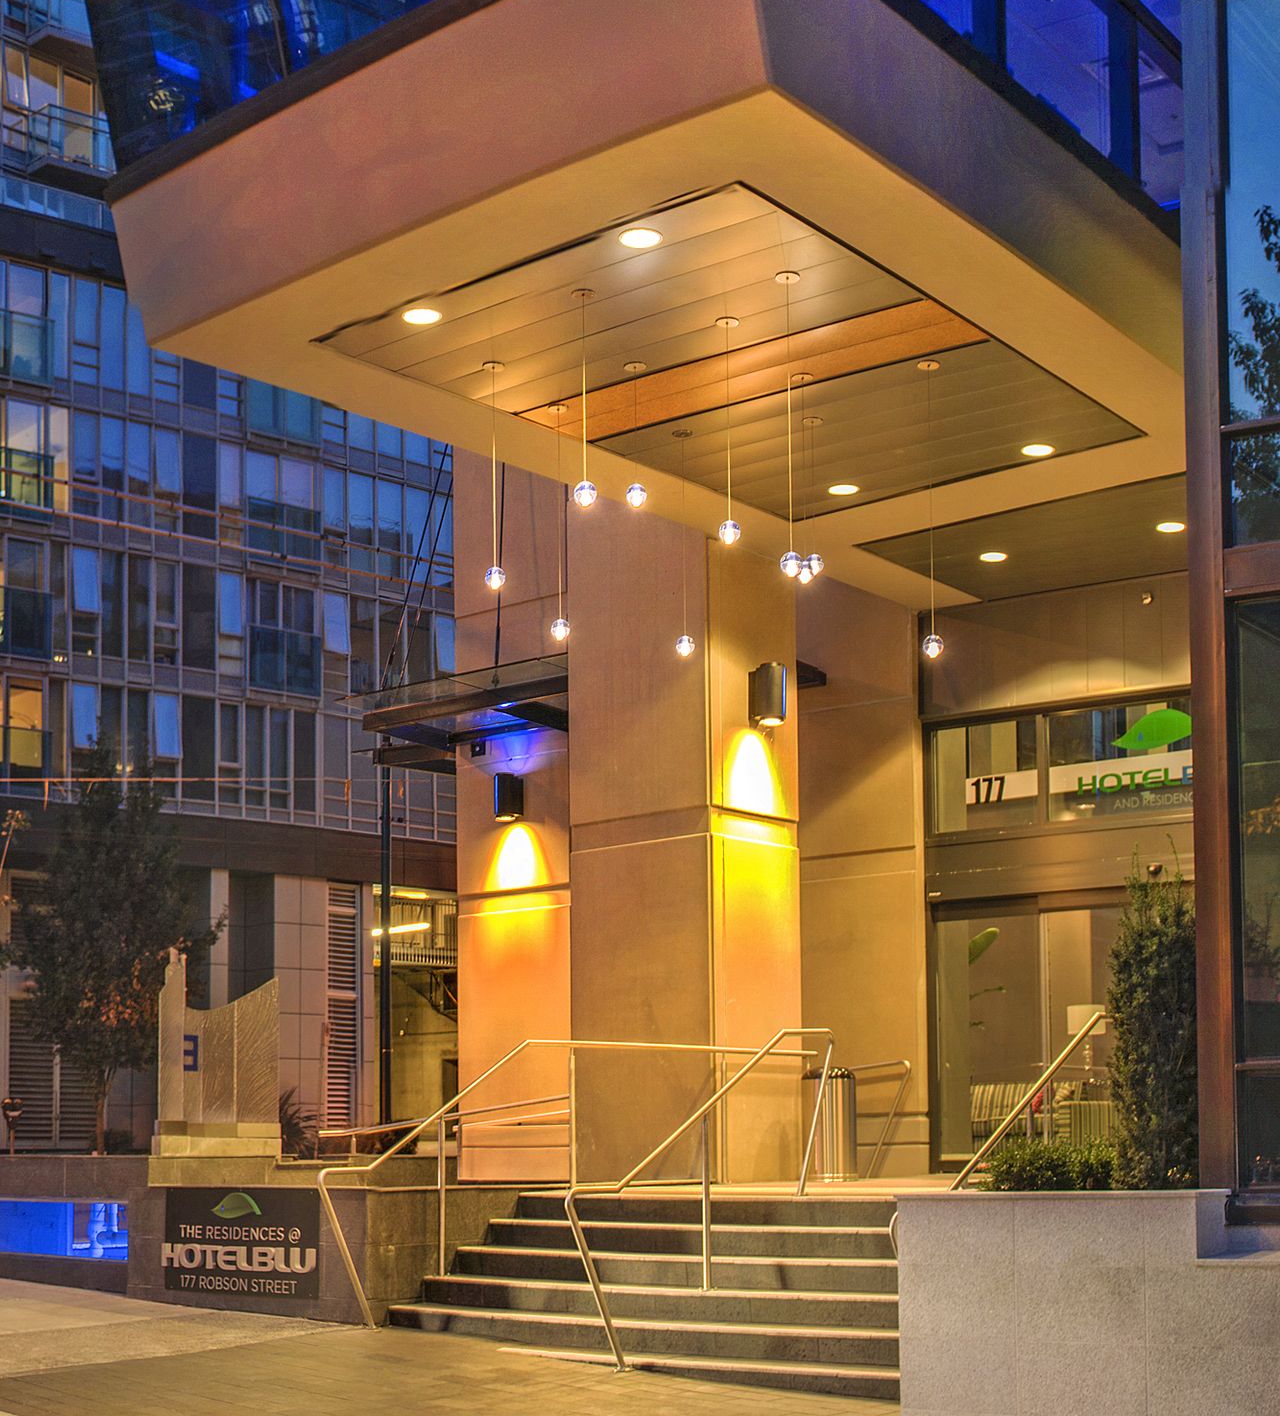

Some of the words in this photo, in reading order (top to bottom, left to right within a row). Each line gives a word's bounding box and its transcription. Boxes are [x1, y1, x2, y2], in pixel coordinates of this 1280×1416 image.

[971, 776, 1006, 804] 177
[1113, 796, 1140, 810] AND
[179, 1224, 203, 1239] THE
[206, 1226, 284, 1241] RESIDENCES
[288, 1227, 301, 1244] @
[161, 1242, 317, 1274] HOTELBLU
[180, 1274, 196, 1289] 177
[199, 1276, 248, 1292] ROBSON
[251, 1278, 297, 1295] STREET
